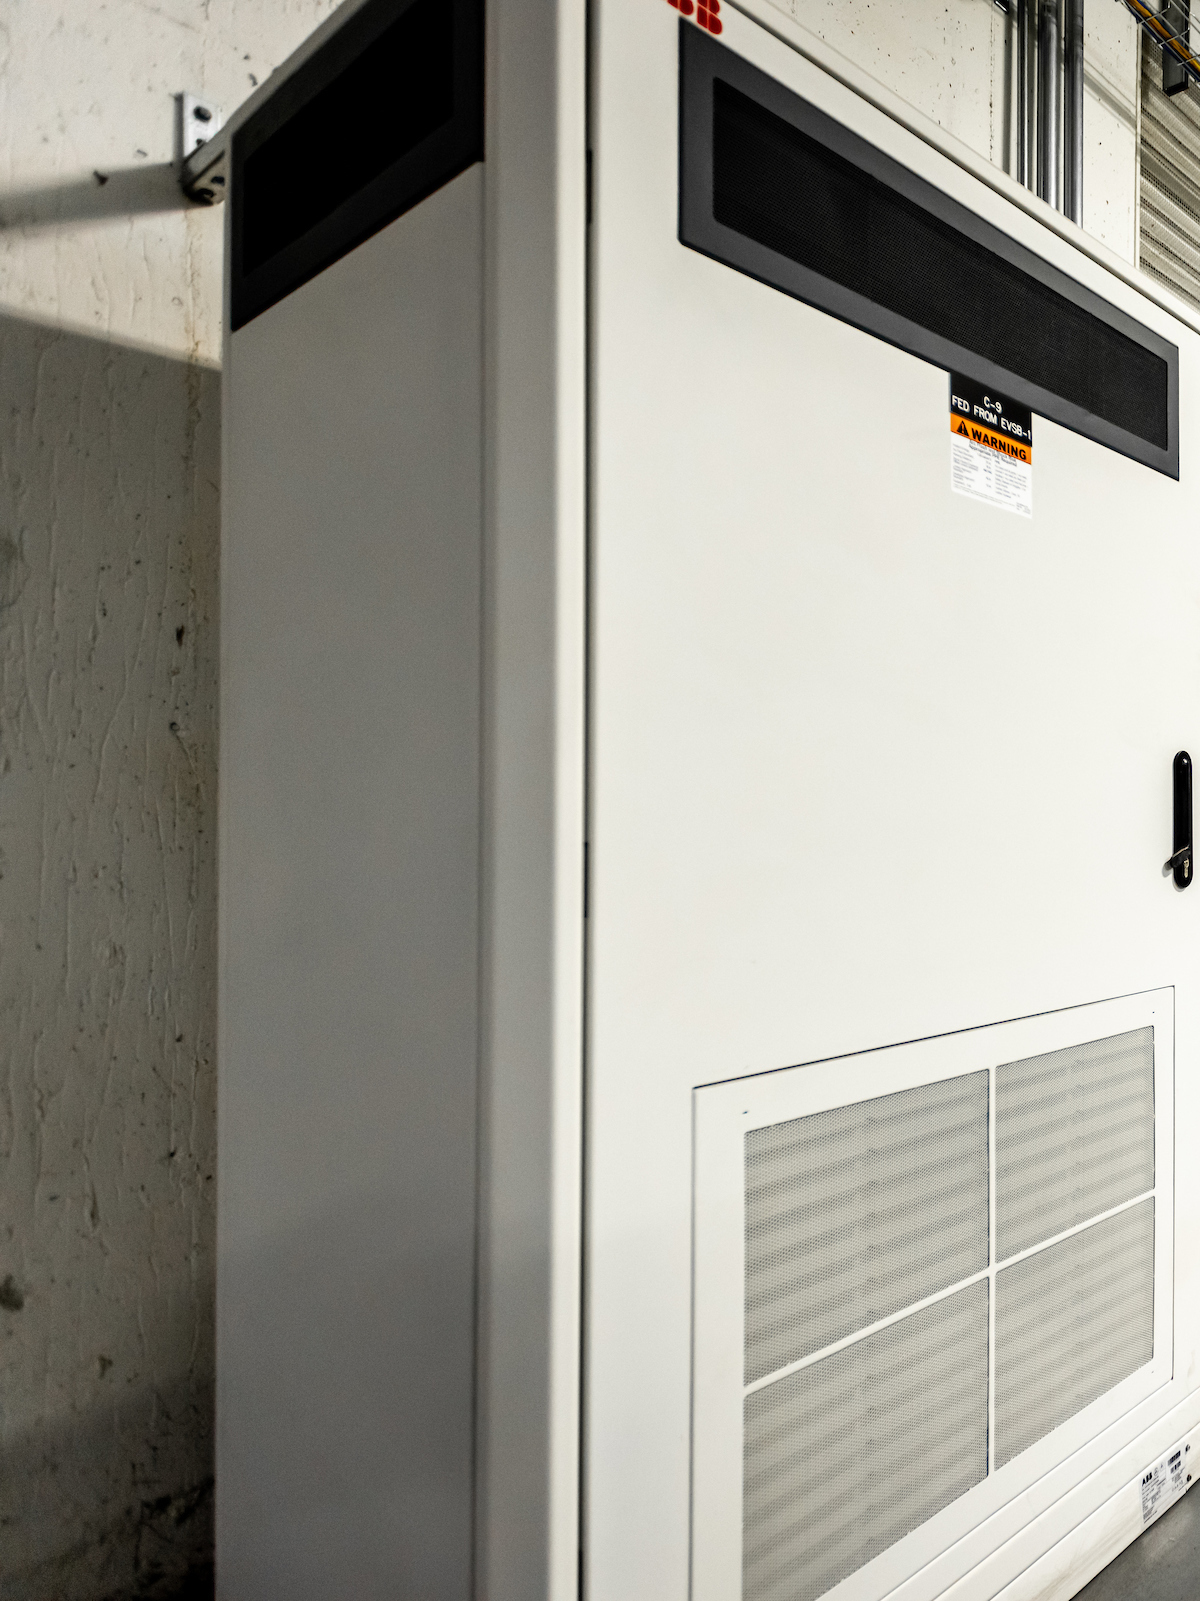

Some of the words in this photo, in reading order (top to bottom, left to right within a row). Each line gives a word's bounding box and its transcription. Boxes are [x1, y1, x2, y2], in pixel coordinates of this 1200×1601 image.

[952, 395, 970, 413] FED
[973, 404, 998, 425] FROM
[1000, 417, 1031, 440] EVSB-1
[983, 396, 1002, 414] C-9
[971, 427, 1027, 460] WARNING
